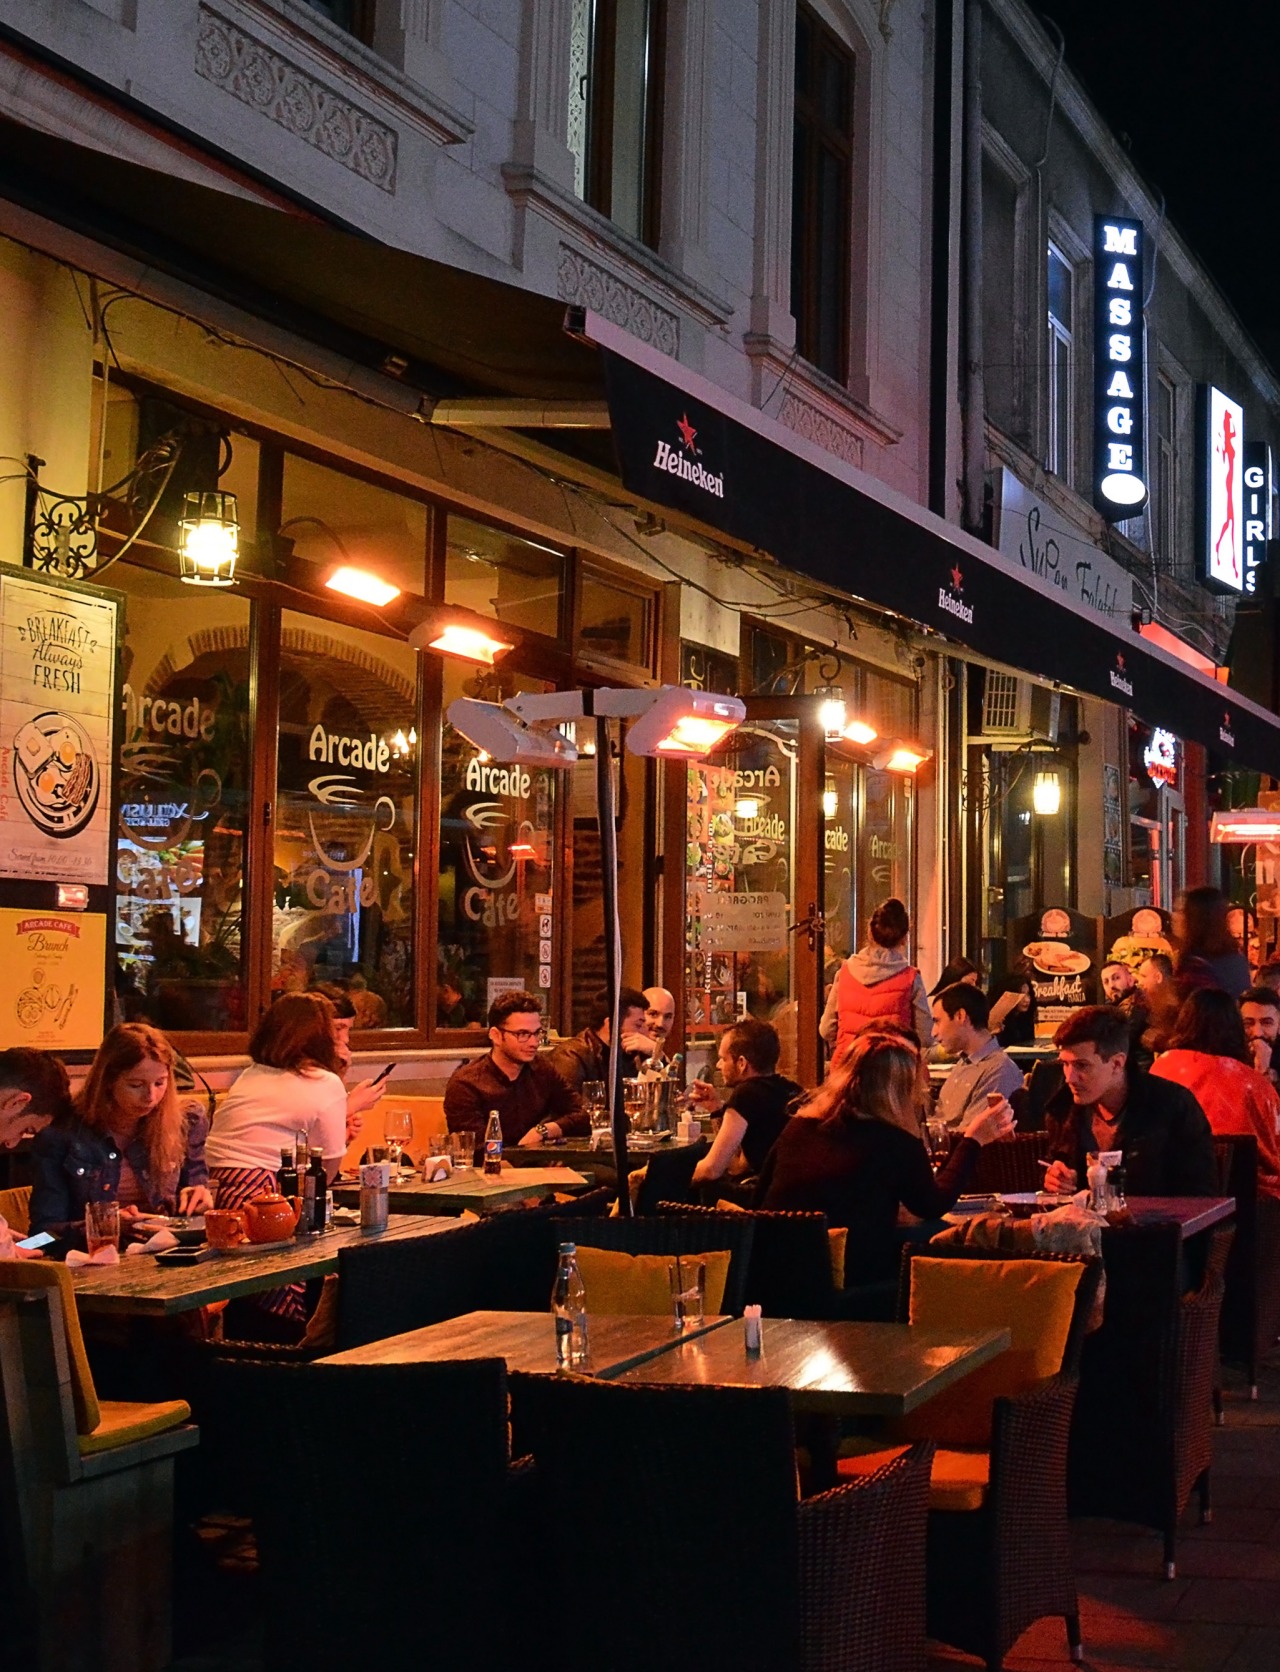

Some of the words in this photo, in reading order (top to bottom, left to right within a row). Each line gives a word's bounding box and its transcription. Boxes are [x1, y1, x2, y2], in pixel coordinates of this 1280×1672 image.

[1103, 225, 1138, 471] MASSAGE
[653, 440, 724, 498] Heineken
[938, 588, 974, 624] Heineken
[27, 616, 91, 652] BREAKFAST
[33, 641, 83, 673] Always
[33, 664, 81, 694] FRESH
[309, 724, 390, 773] Arcade
[466, 757, 531, 799] Arcade
[306, 868, 378, 914] Cafe
[464, 886, 521, 927] Cafe
[27, 932, 70, 952] Brunch
